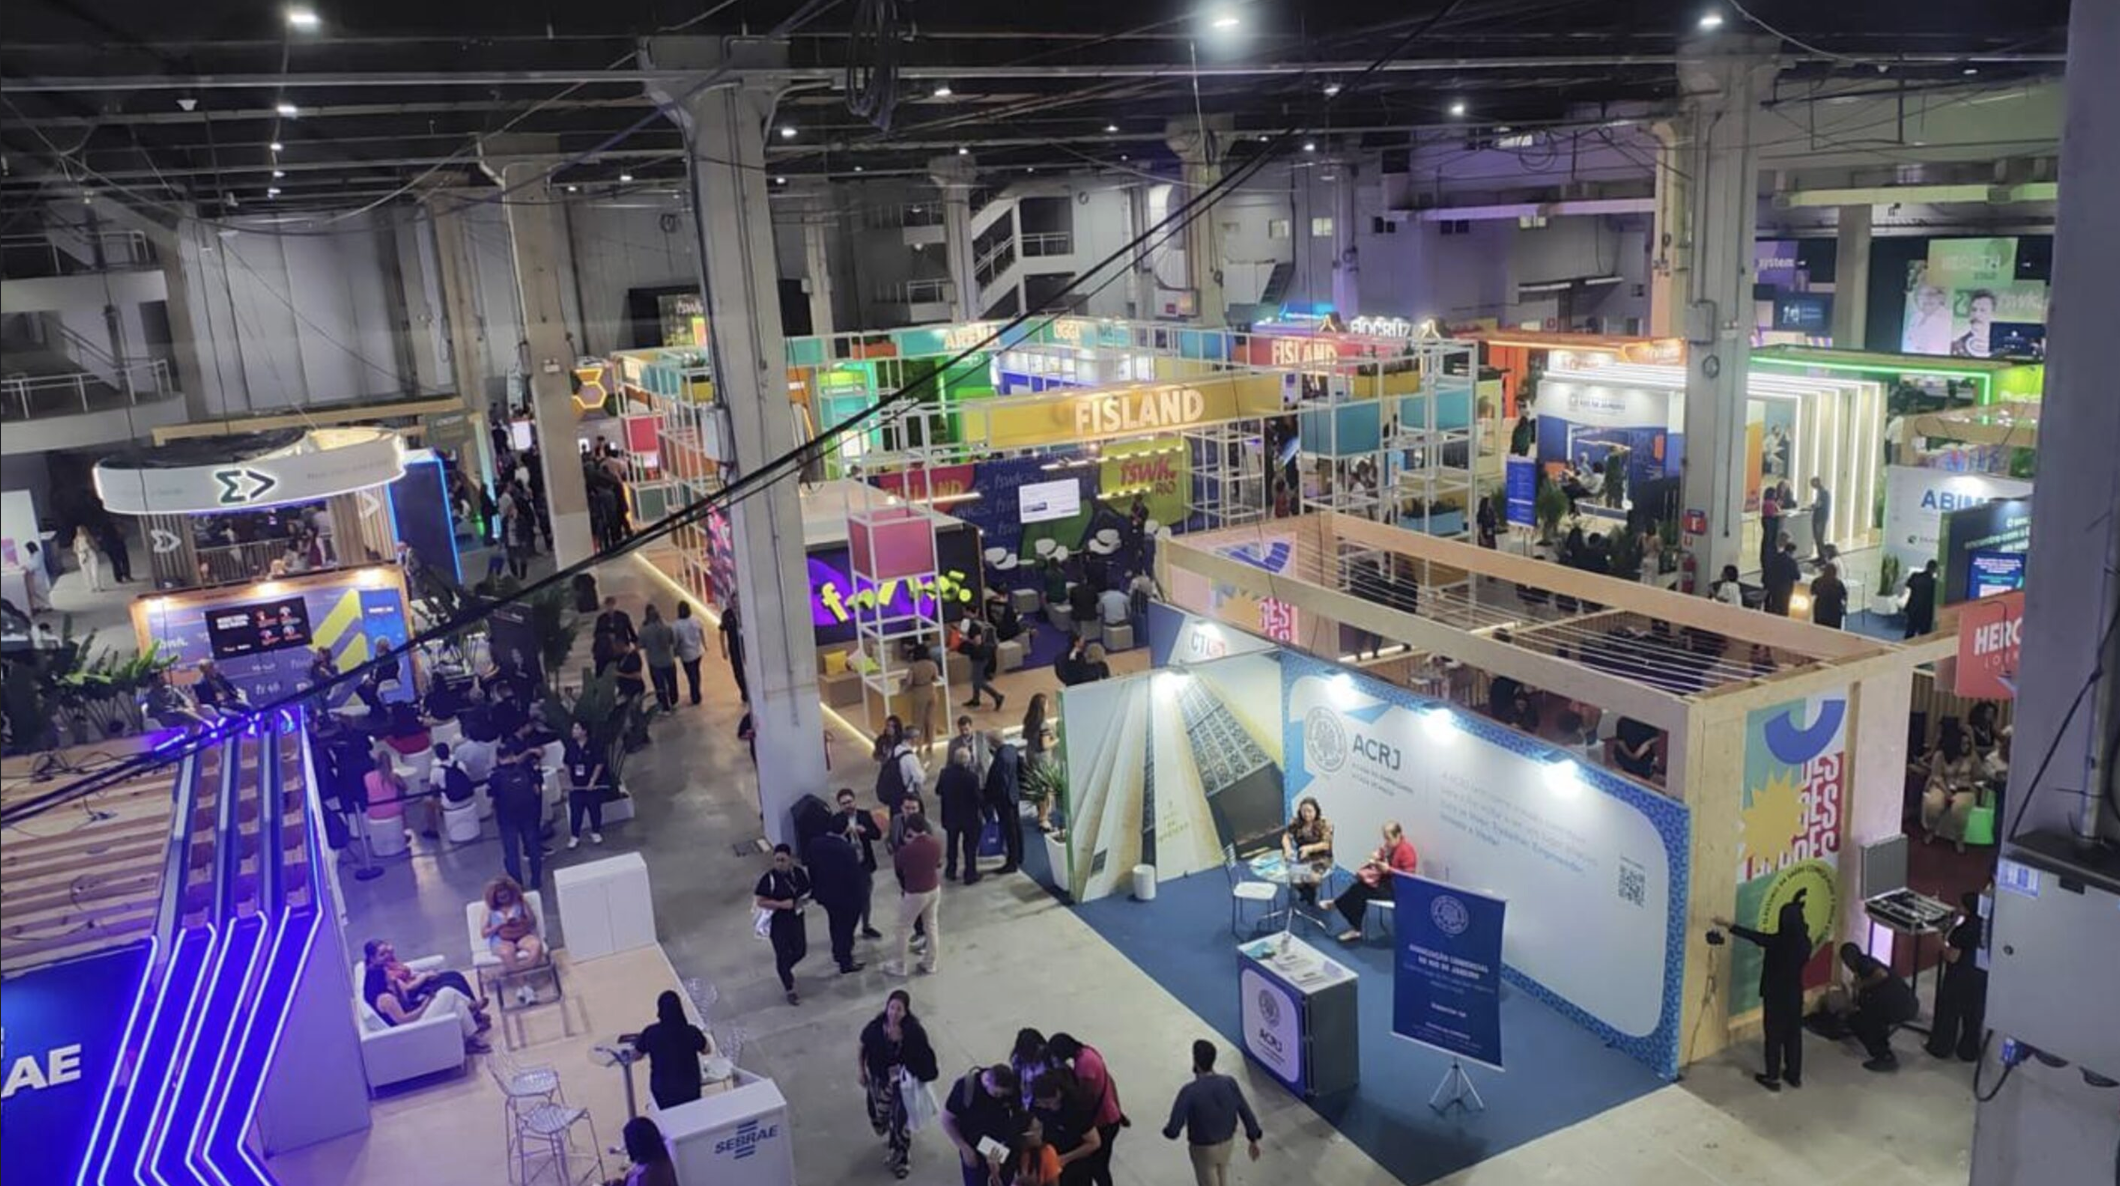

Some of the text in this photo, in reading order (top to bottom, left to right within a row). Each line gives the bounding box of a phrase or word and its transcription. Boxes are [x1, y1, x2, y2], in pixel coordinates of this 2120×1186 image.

[1271, 339, 1339, 366] FISLAND
[1075, 389, 1205, 436] FISLAND
[1154, 480, 1176, 497] RIO
[1352, 733, 1402, 771] ACRJ
[714, 1124, 779, 1154] SEBRAE
